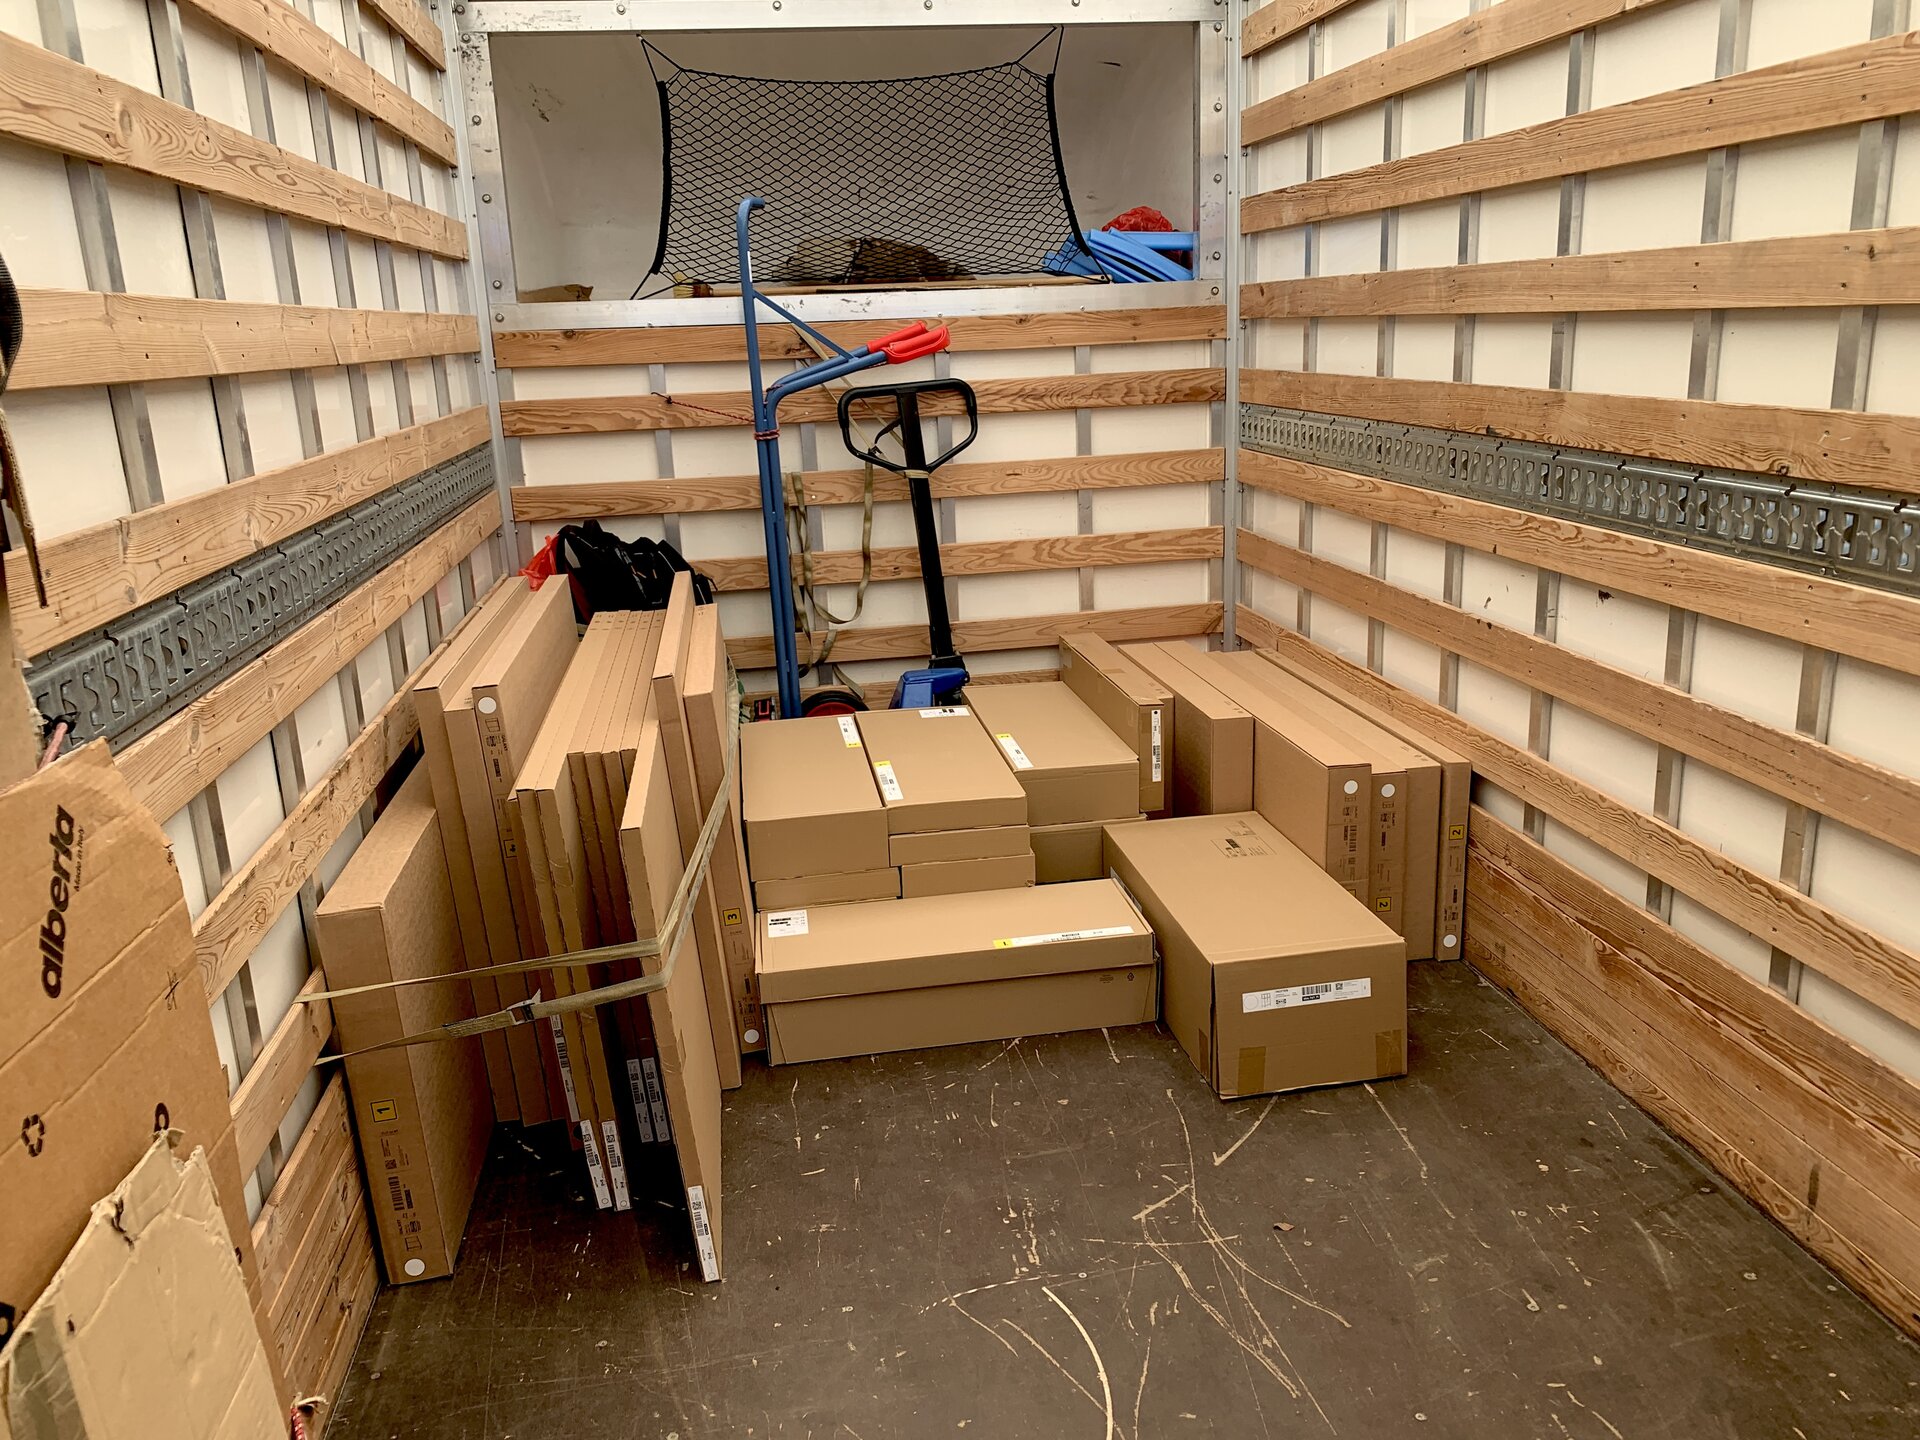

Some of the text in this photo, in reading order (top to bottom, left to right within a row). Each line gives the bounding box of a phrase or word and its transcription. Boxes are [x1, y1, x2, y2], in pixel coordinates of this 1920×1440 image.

[76, 849, 82, 860] in
[74, 861, 82, 892] Made
[39, 804, 74, 999] alberta
